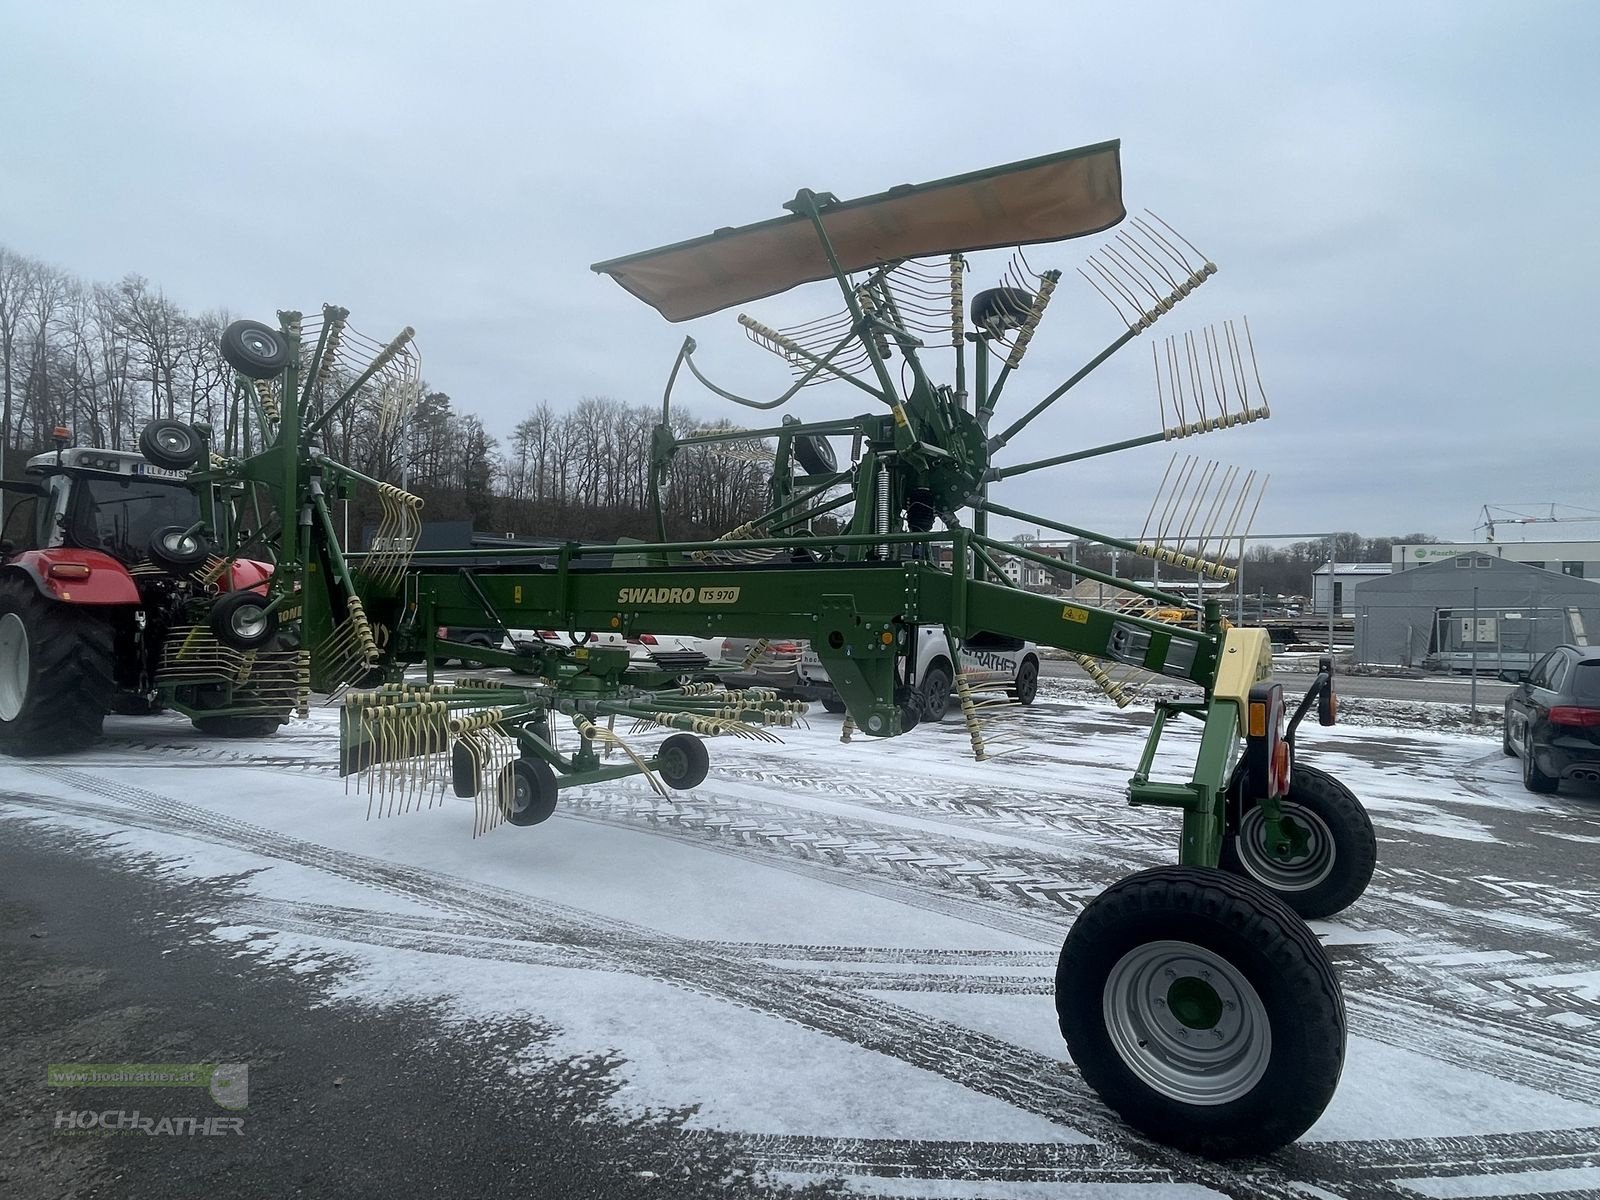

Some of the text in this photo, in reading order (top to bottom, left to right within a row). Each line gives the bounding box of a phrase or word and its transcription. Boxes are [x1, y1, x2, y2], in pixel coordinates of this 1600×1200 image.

[617, 587, 735, 604] SWADRO TS 970
